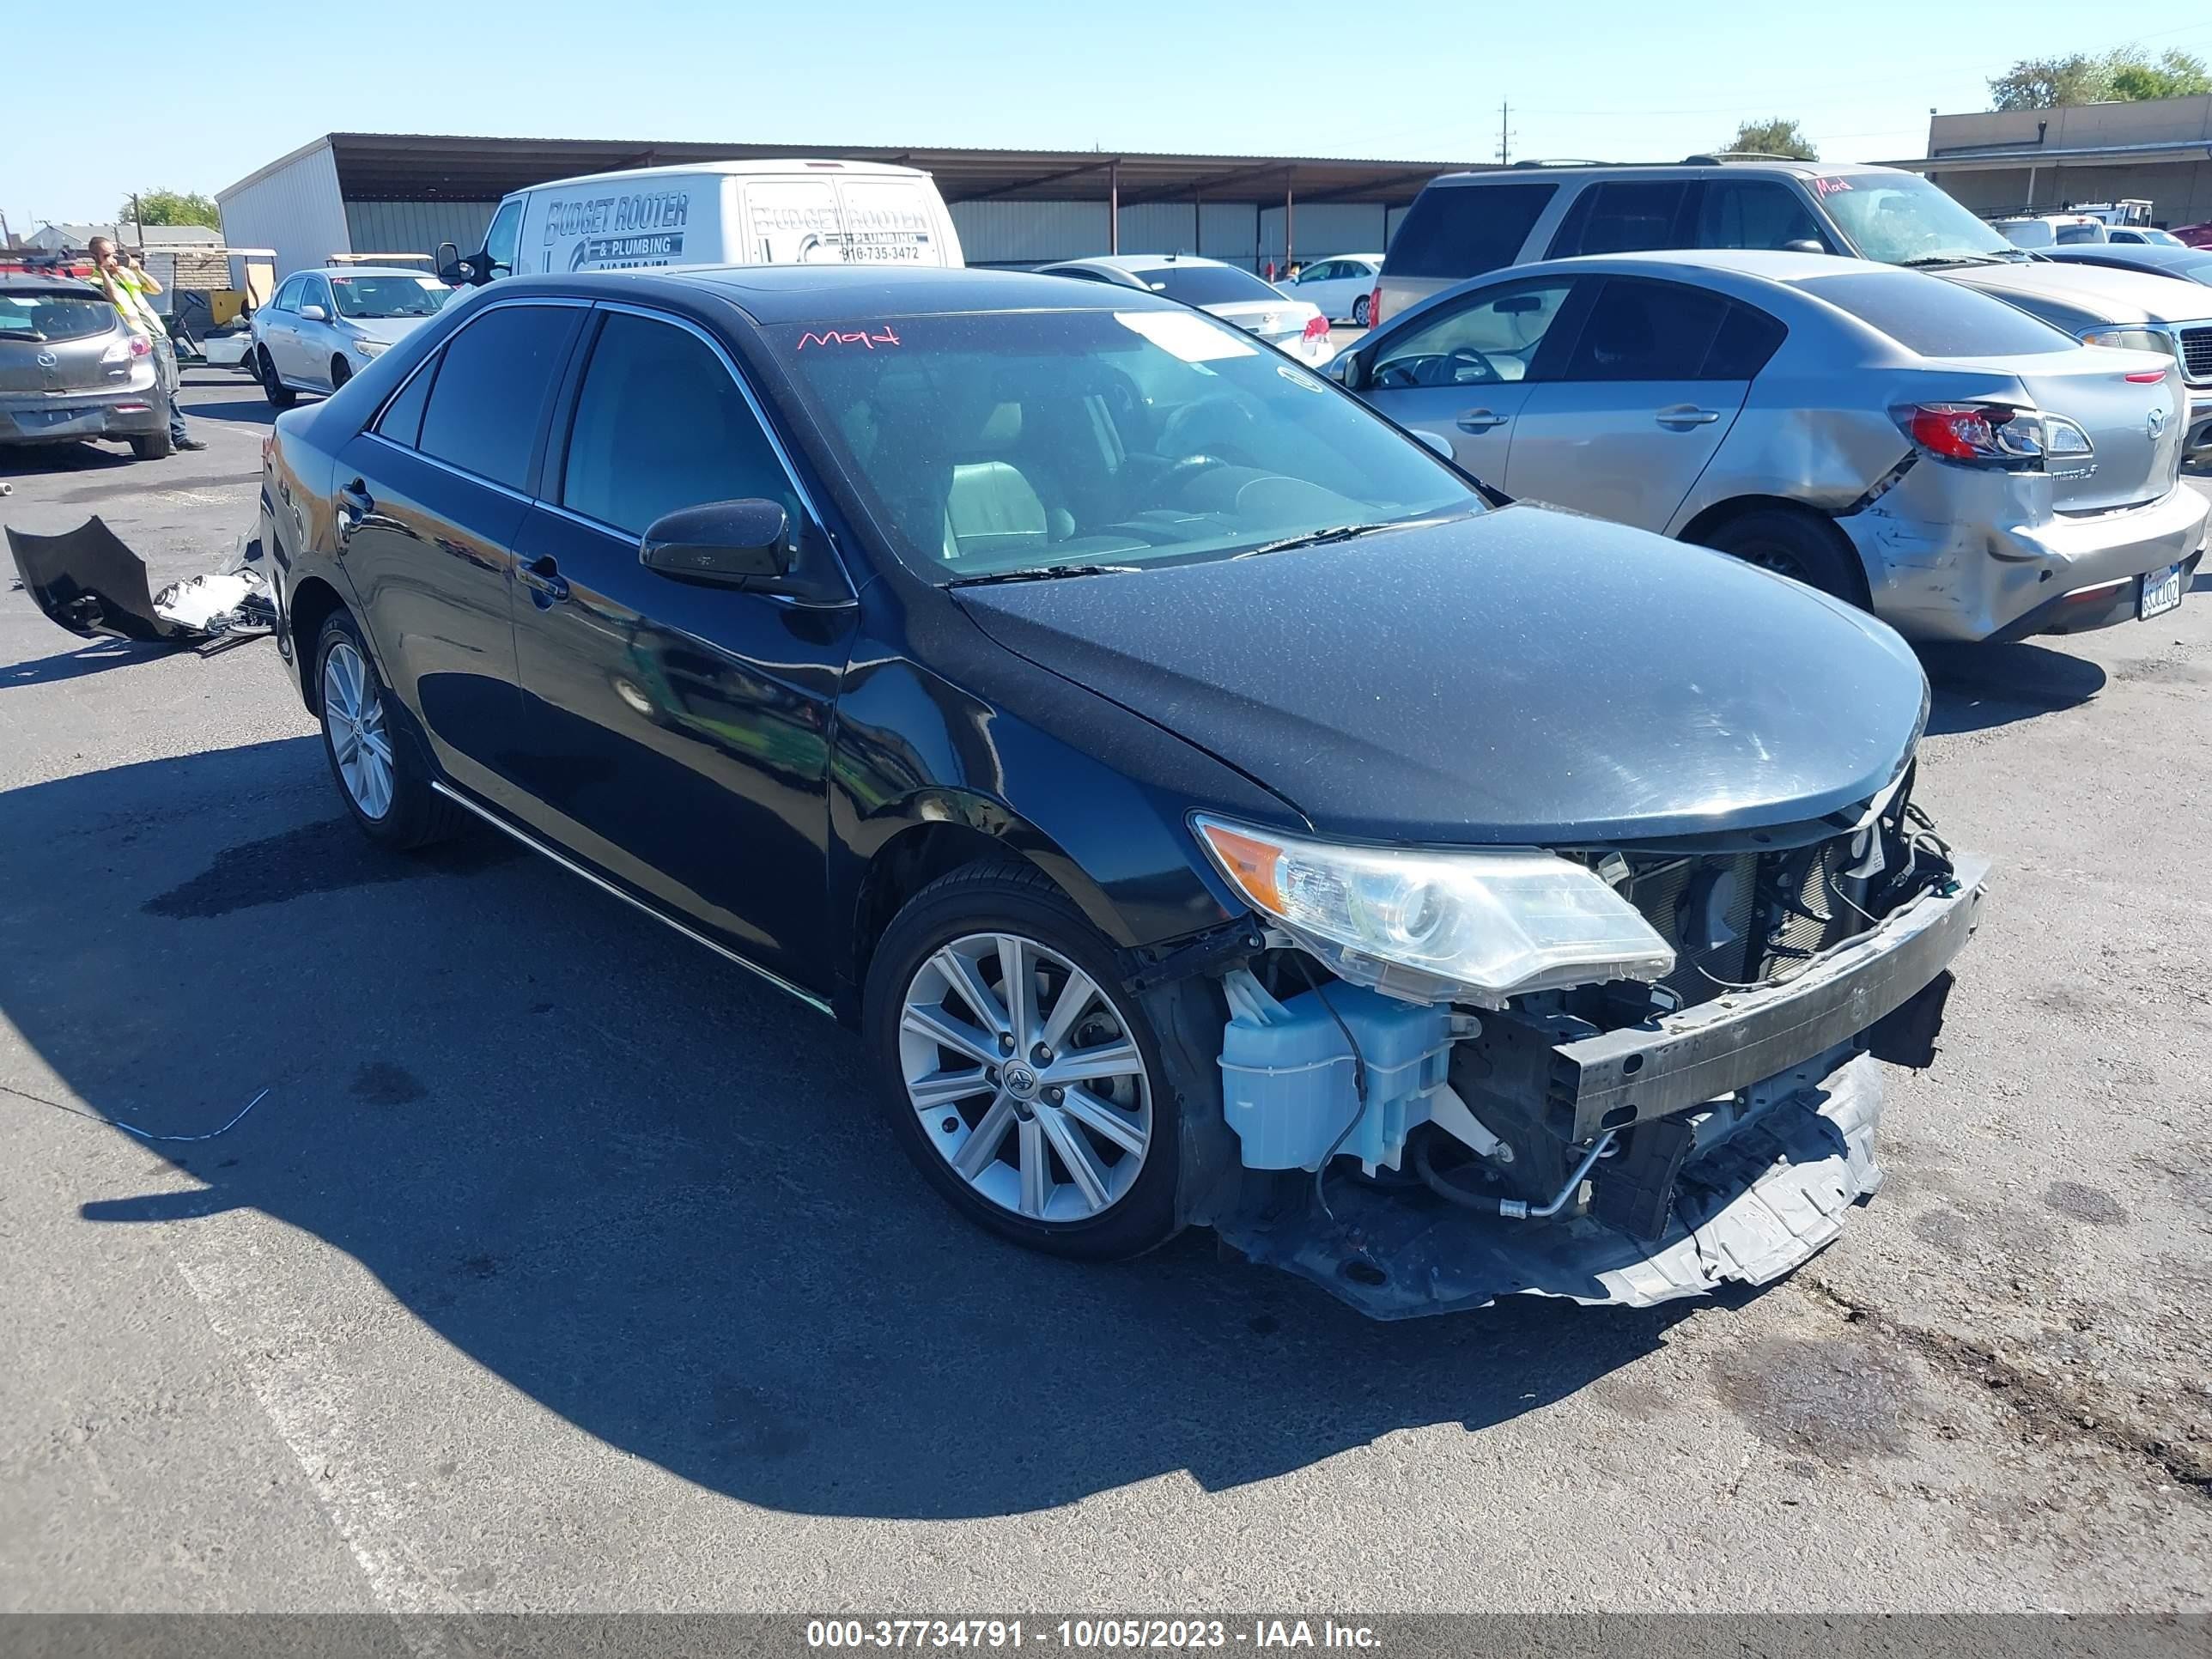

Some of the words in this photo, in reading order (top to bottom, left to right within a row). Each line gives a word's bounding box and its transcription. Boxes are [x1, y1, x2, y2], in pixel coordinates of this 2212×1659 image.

[1815, 176, 1854, 198] Mad
[544, 198, 615, 246] BUDGET
[614, 189, 690, 231] ROOTER
[599, 245, 607, 257] &
[611, 236, 672, 256] PLUMBING
[797, 325, 900, 350] Mad
[2143, 580, 2178, 612] 6SJC102
